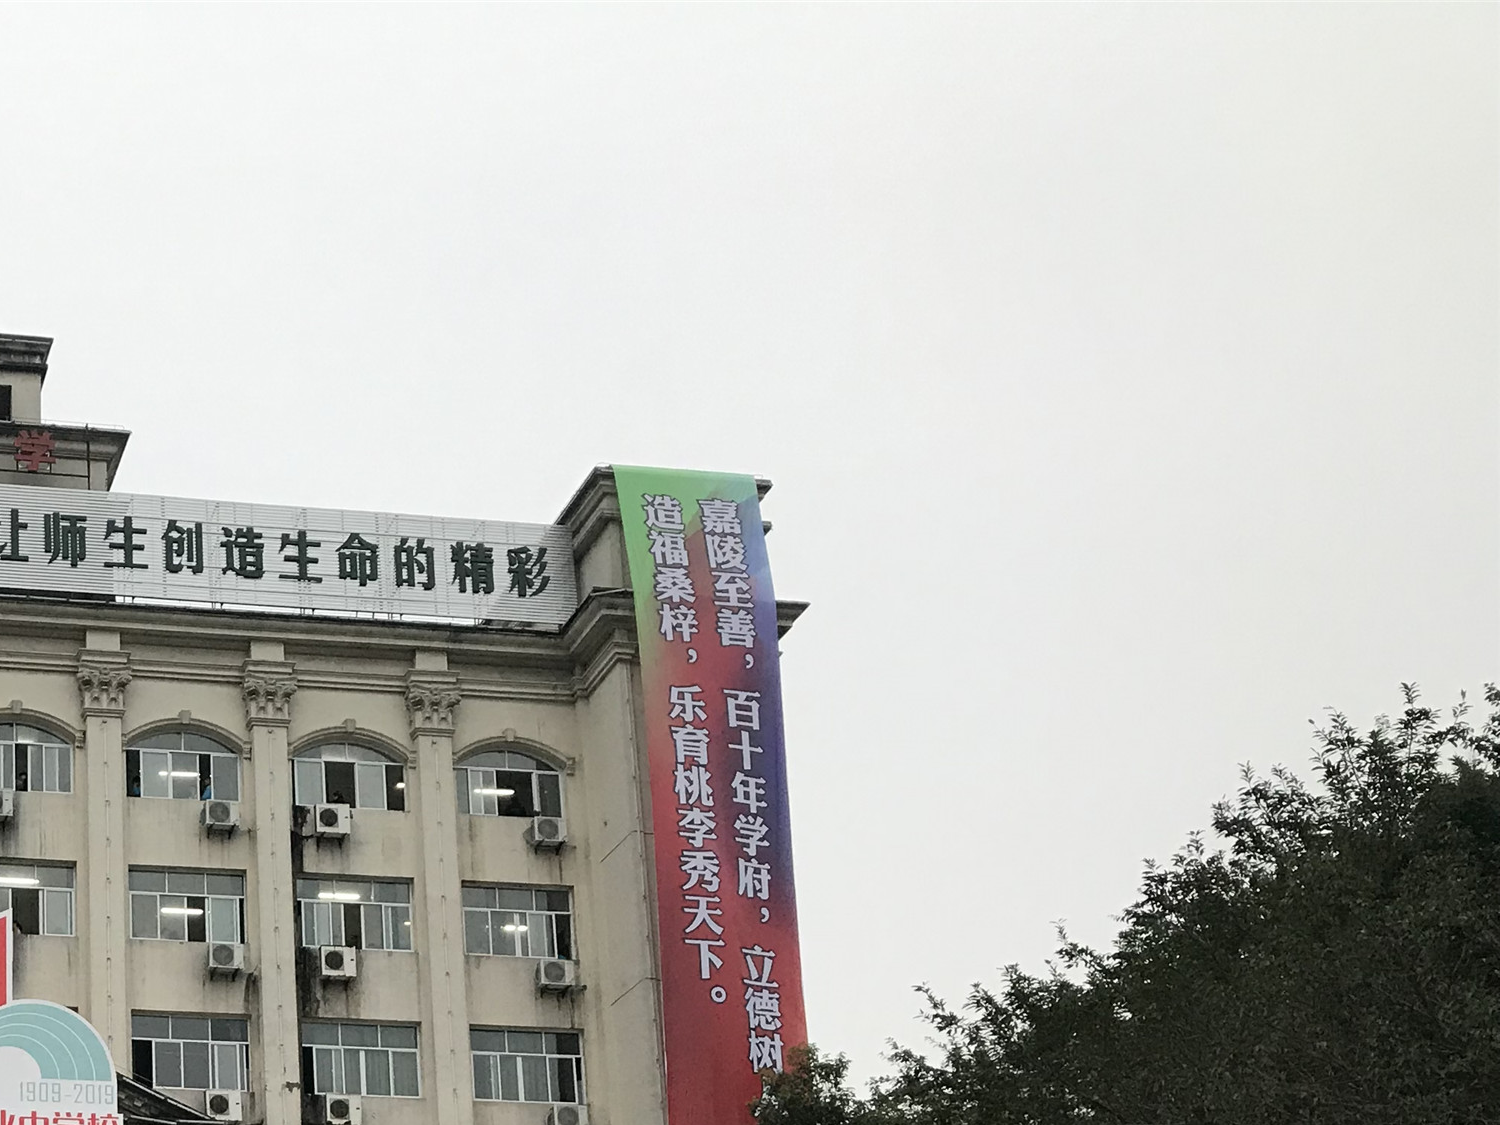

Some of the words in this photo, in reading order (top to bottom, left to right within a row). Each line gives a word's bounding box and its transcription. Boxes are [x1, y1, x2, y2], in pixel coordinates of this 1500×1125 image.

[641, 493, 729, 1005] 造福桑梓，乐育桃李秀天下。
[19, 1080, 115, 1104] 1909-2019
